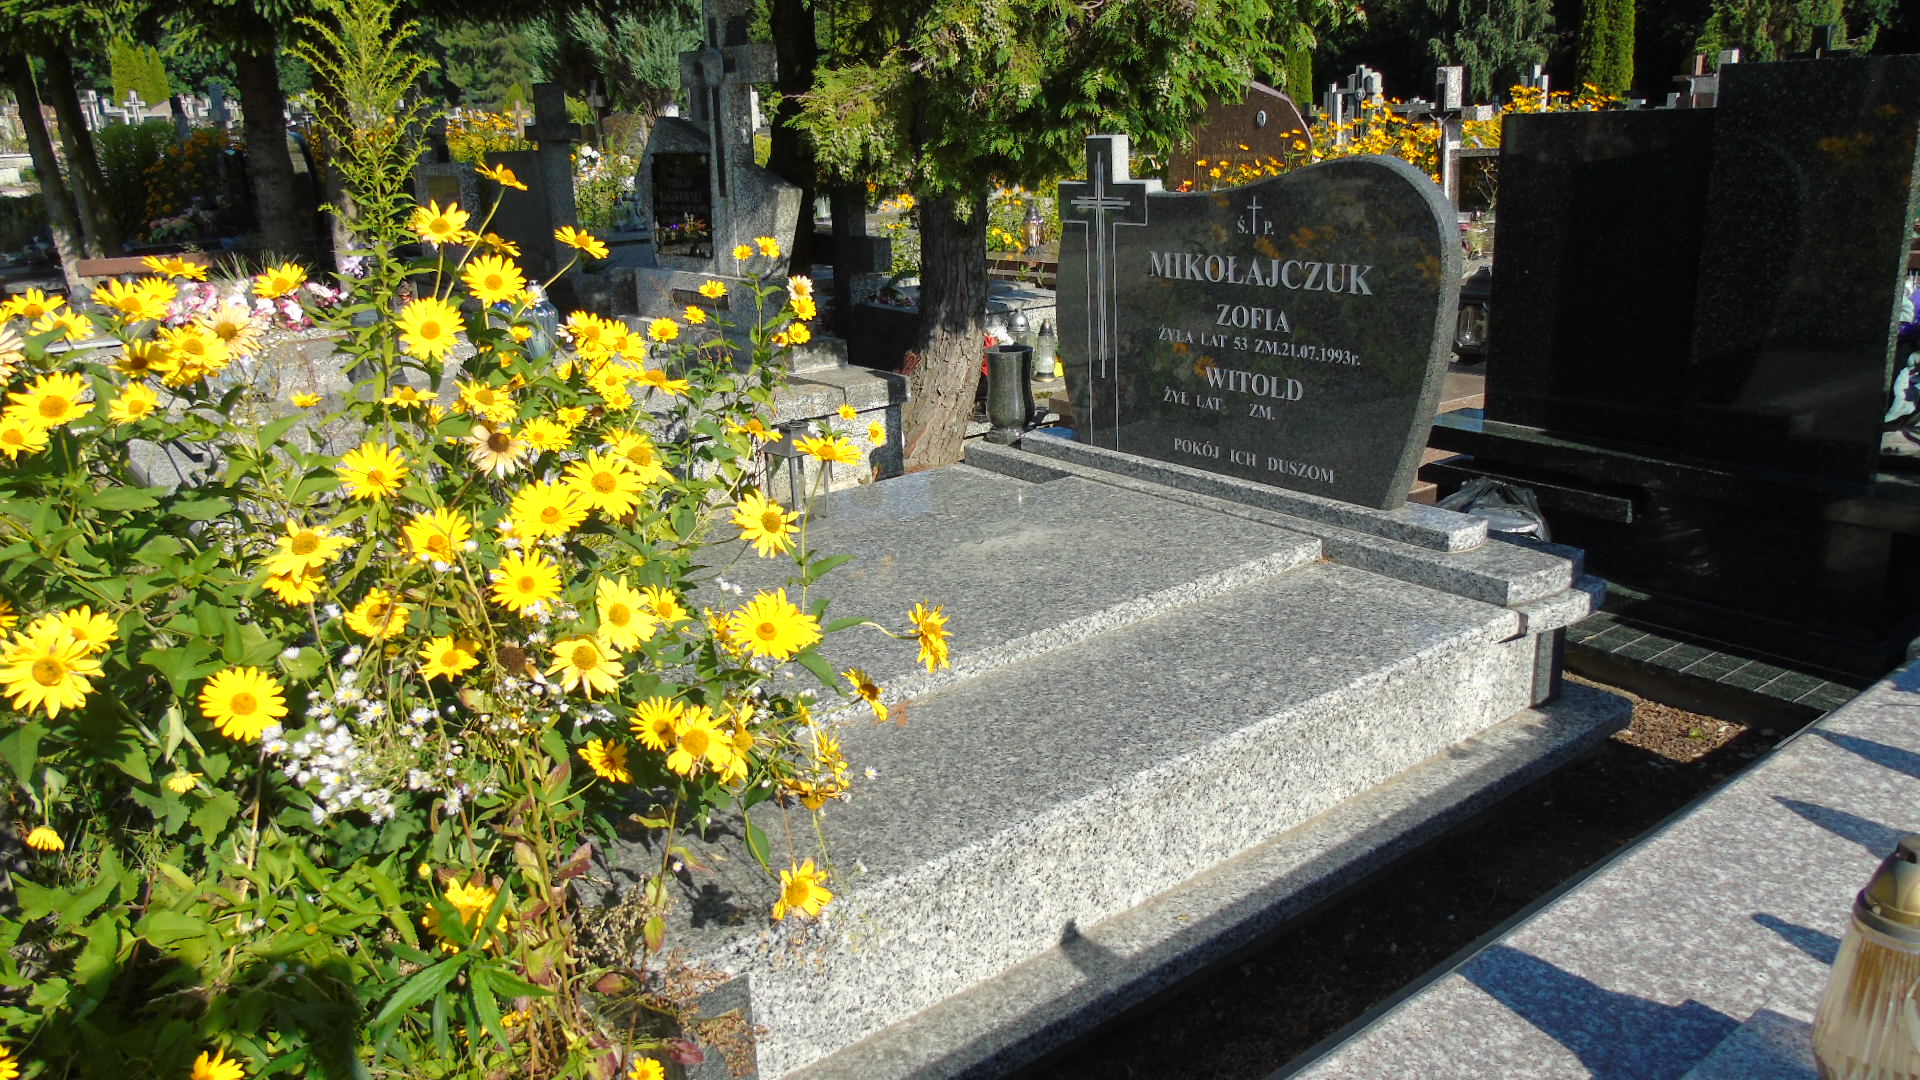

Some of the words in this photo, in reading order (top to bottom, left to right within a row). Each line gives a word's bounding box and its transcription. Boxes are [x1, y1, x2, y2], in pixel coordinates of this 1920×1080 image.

[1237, 216, 1249, 234] Ś.
[1264, 220, 1275, 235] P.
[1150, 251, 1374, 295] MIKOŁAJCZUK
[1216, 304, 1291, 333] ZOFIA
[1158, 325, 1194, 344] ŻYŁA
[1201, 332, 1228, 348] LAT
[1233, 337, 1248, 350] 53
[1205, 367, 1304, 401] WITOLD
[1249, 403, 1276, 421] ZM.
[1174, 437, 1220, 459] POKÓJ
[1230, 449, 1257, 467] ICH
[1267, 456, 1335, 484] DUSZOM
